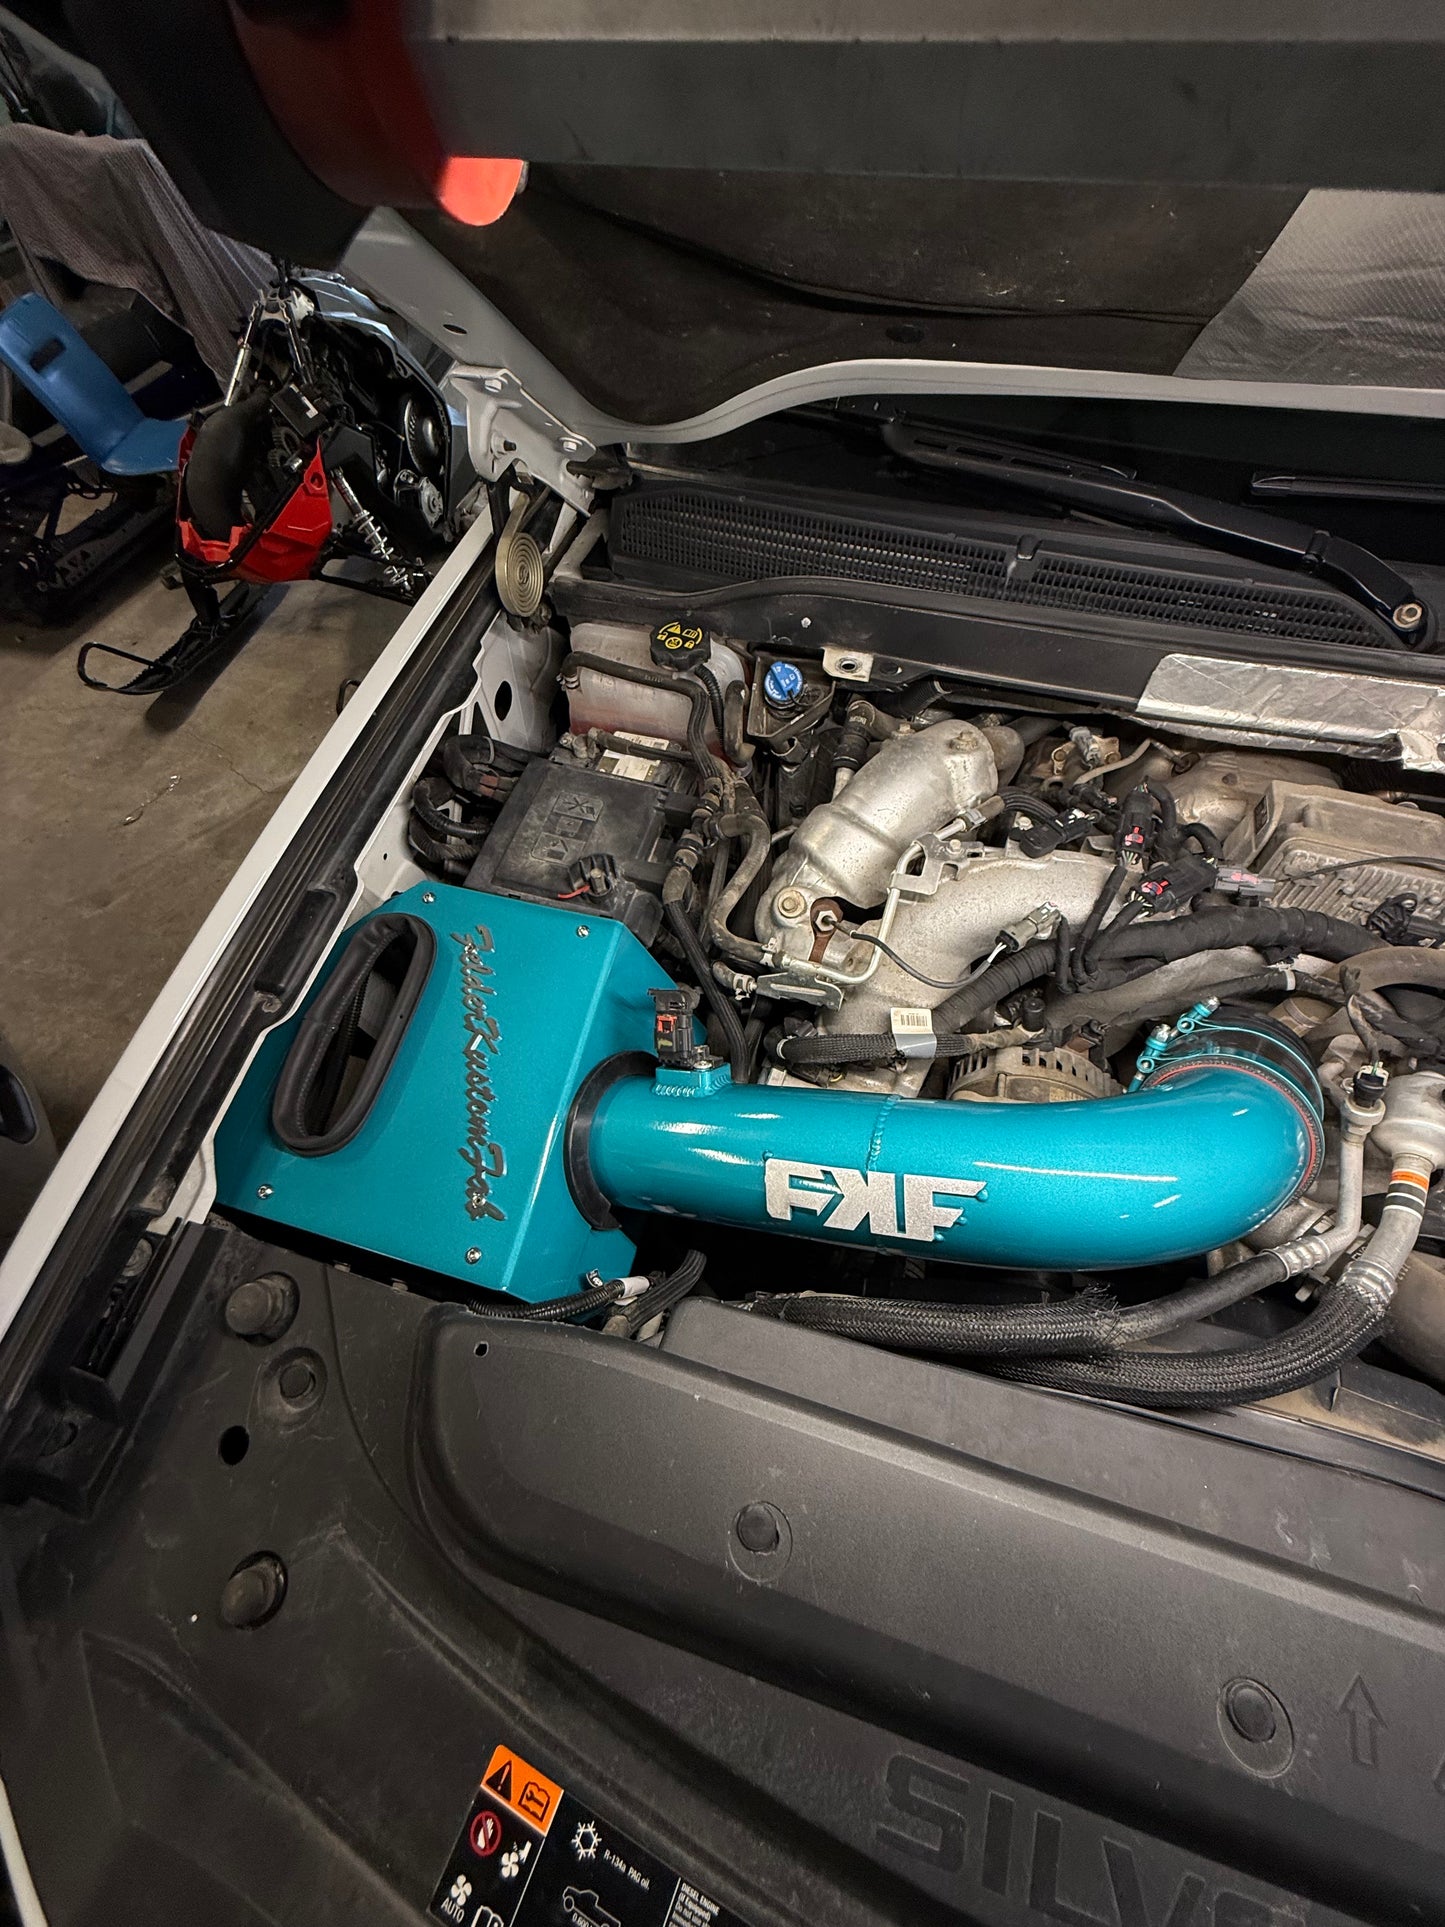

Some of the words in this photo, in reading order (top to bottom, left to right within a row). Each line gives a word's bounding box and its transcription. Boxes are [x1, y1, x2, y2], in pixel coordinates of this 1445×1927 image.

[604, 1849, 626, 1873] R-134a
[628, 1866, 642, 1883] PAG
[440, 1897, 465, 1924] AUTO
[681, 1882, 699, 1902] DIESEL
[700, 1895, 720, 1917] ENGINE
